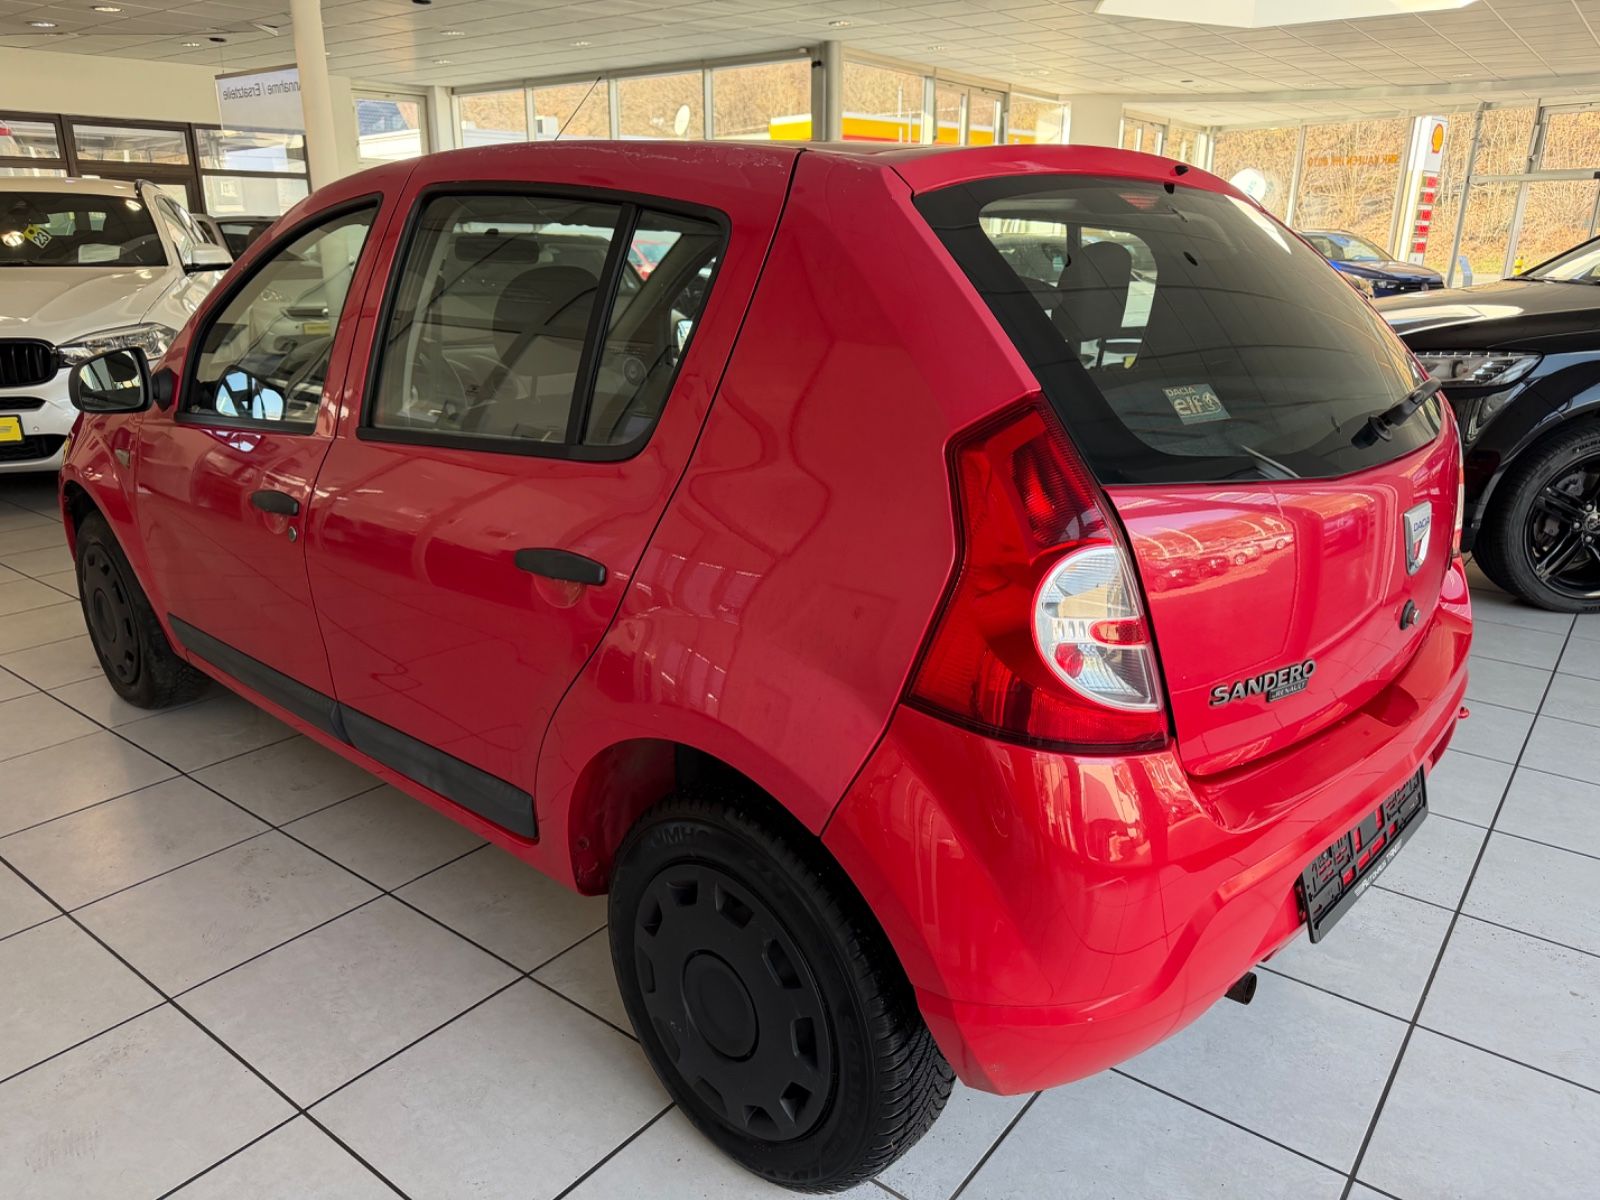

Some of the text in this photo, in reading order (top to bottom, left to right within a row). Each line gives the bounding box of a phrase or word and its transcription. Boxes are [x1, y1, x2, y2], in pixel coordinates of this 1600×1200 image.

[33, 231, 49, 246] 23
[1165, 386, 1196, 397] DACIA
[1173, 394, 1202, 415] elf
[1209, 659, 1316, 706] SANDERO
[1275, 682, 1306, 698] RENAULT
